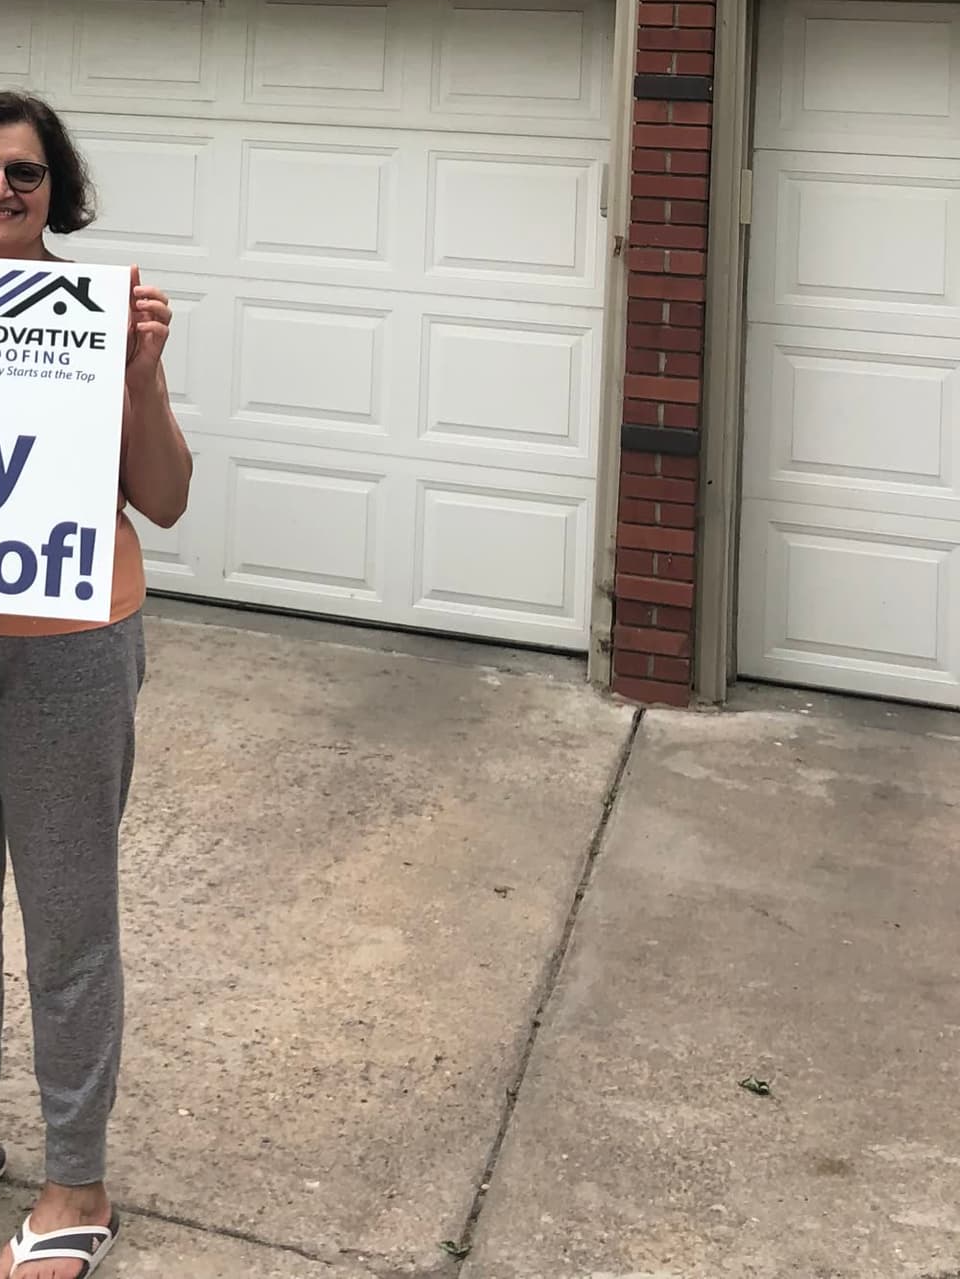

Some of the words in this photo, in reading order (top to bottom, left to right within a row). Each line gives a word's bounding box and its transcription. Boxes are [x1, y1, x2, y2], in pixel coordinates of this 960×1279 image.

[6, 365, 38, 378] Starts
[40, 368, 52, 379] at
[54, 368, 72, 380] the
[76, 370, 96, 383] Top
